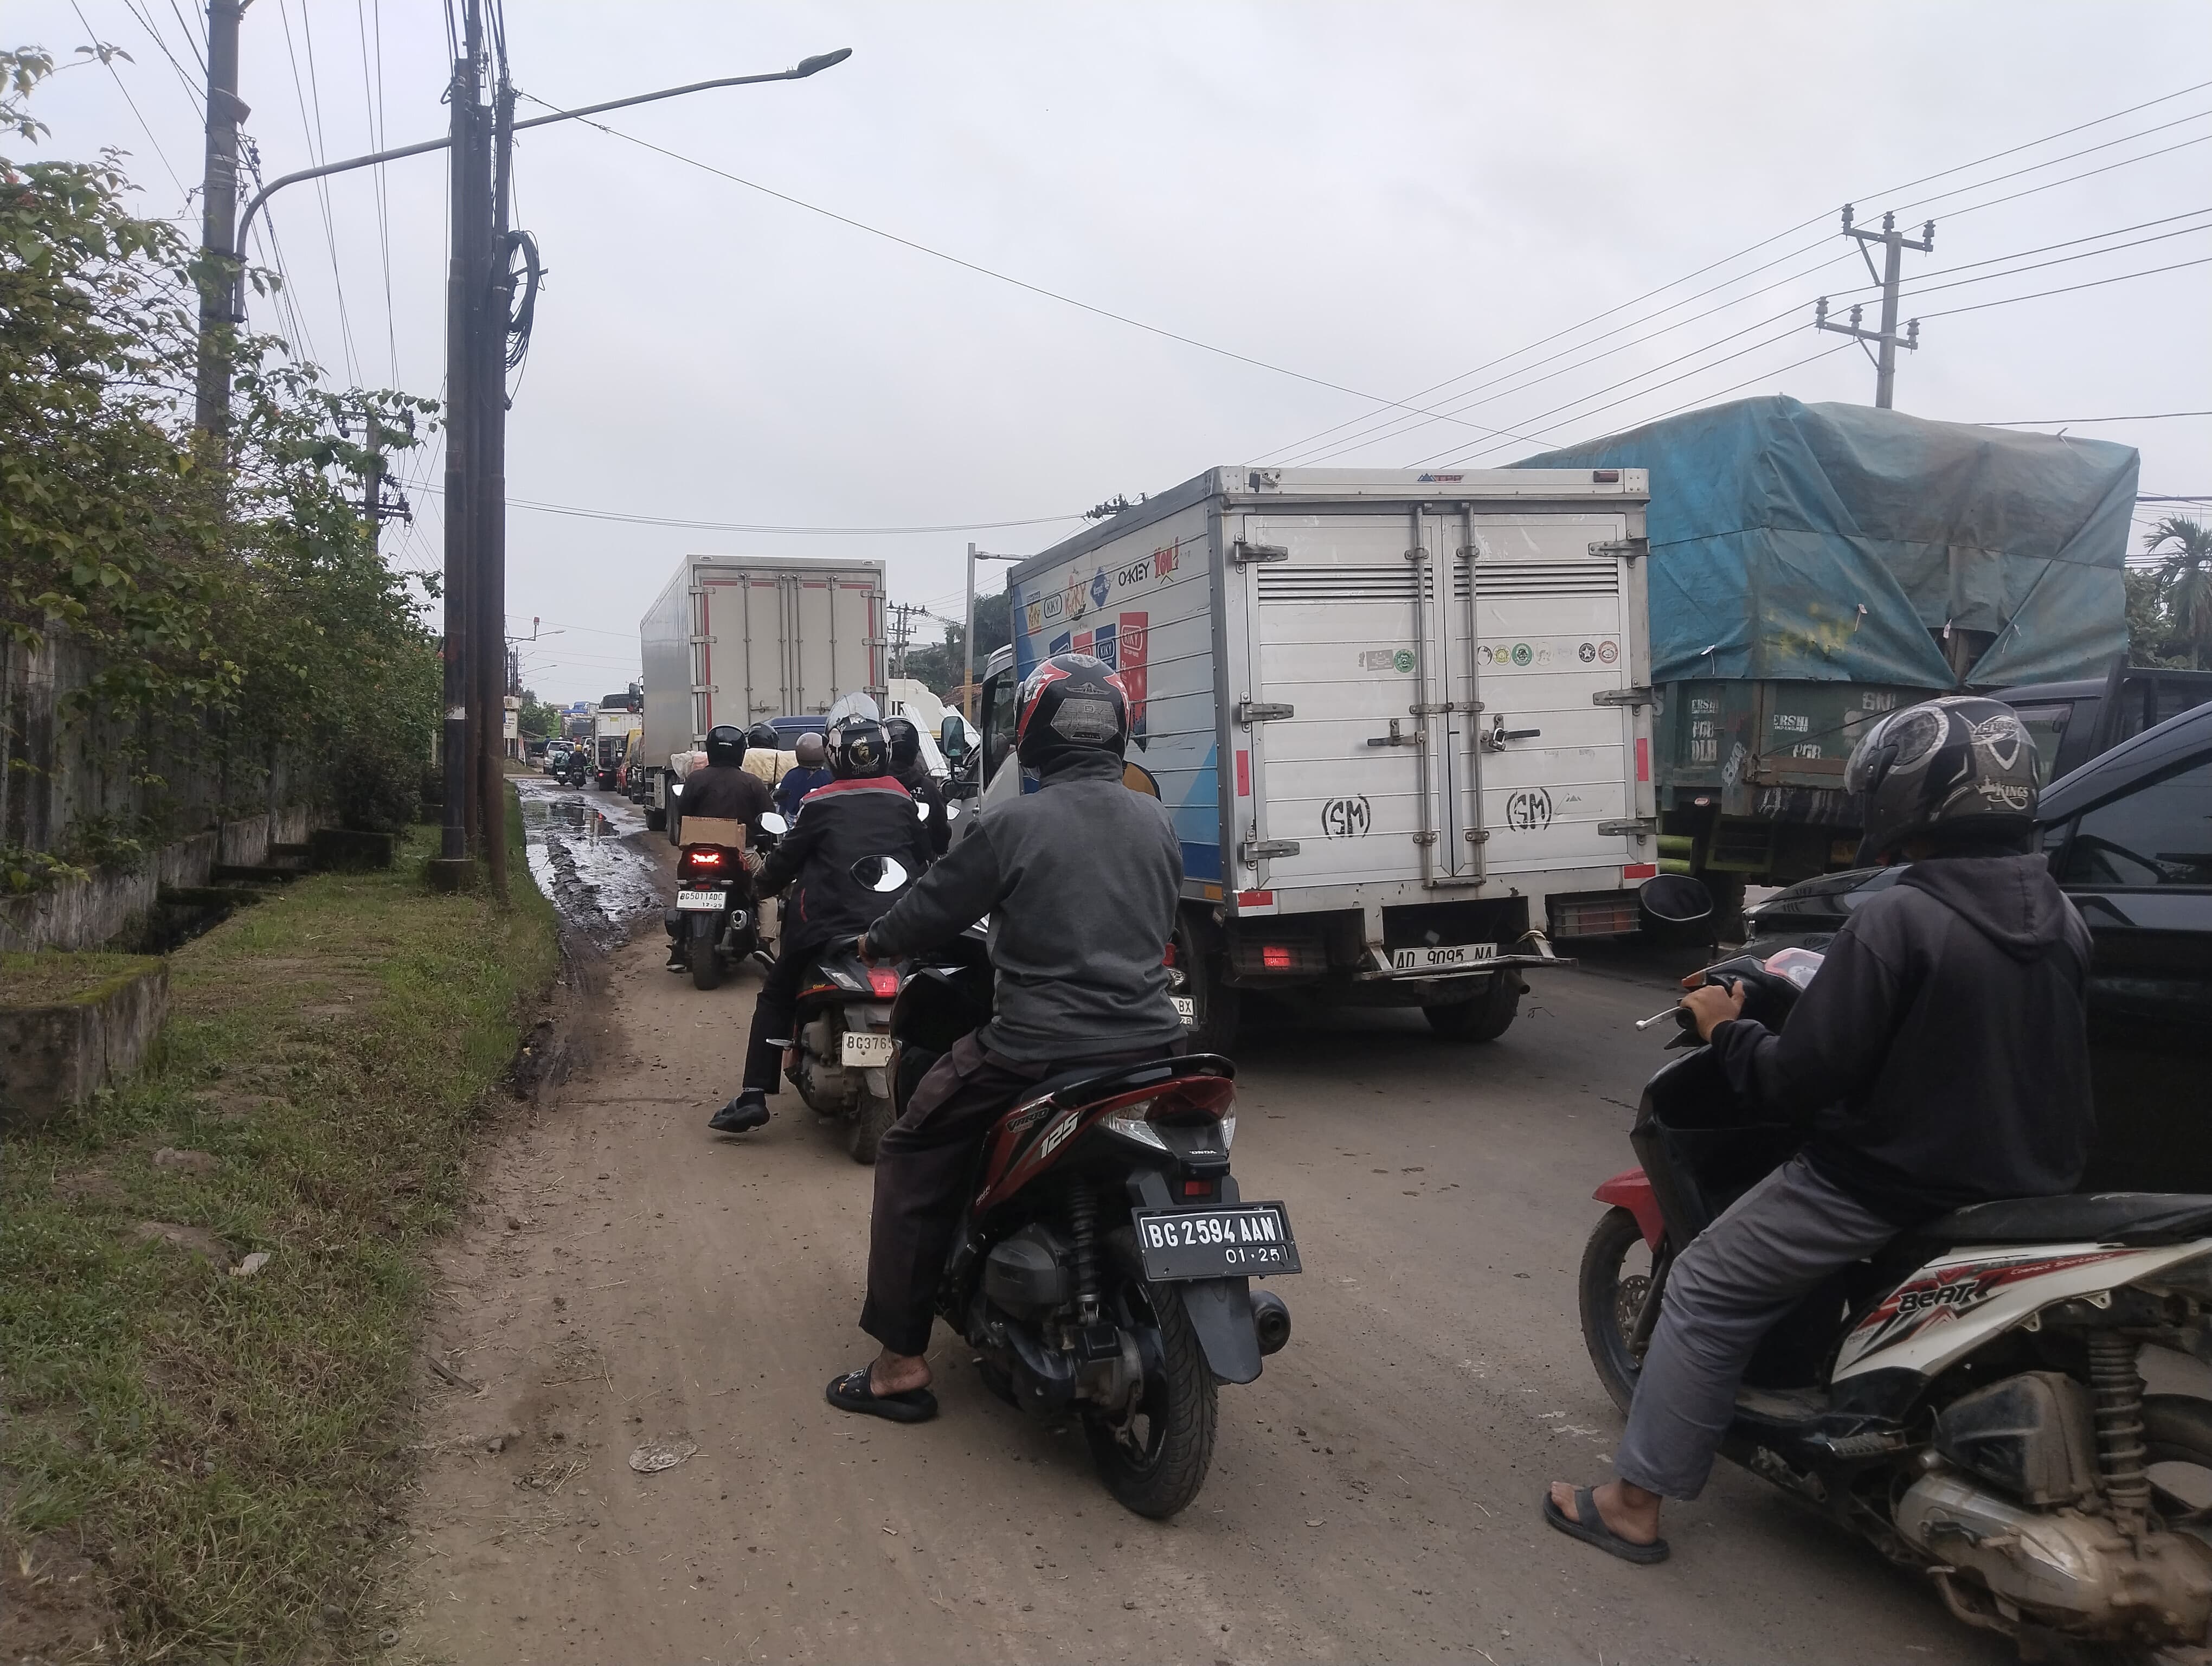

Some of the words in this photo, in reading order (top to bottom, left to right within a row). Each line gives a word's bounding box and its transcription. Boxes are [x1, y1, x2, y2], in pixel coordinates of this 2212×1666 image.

[1100, 643, 1111, 657] KIKY
[1396, 951, 1415, 969] AD
[1179, 1000, 1191, 1013] BX
[1040, 1111, 1081, 1159] 125
[1148, 1222, 1178, 1247] BG
[1181, 1219, 1236, 1245] 2594
[1239, 1216, 1276, 1242] AAN
